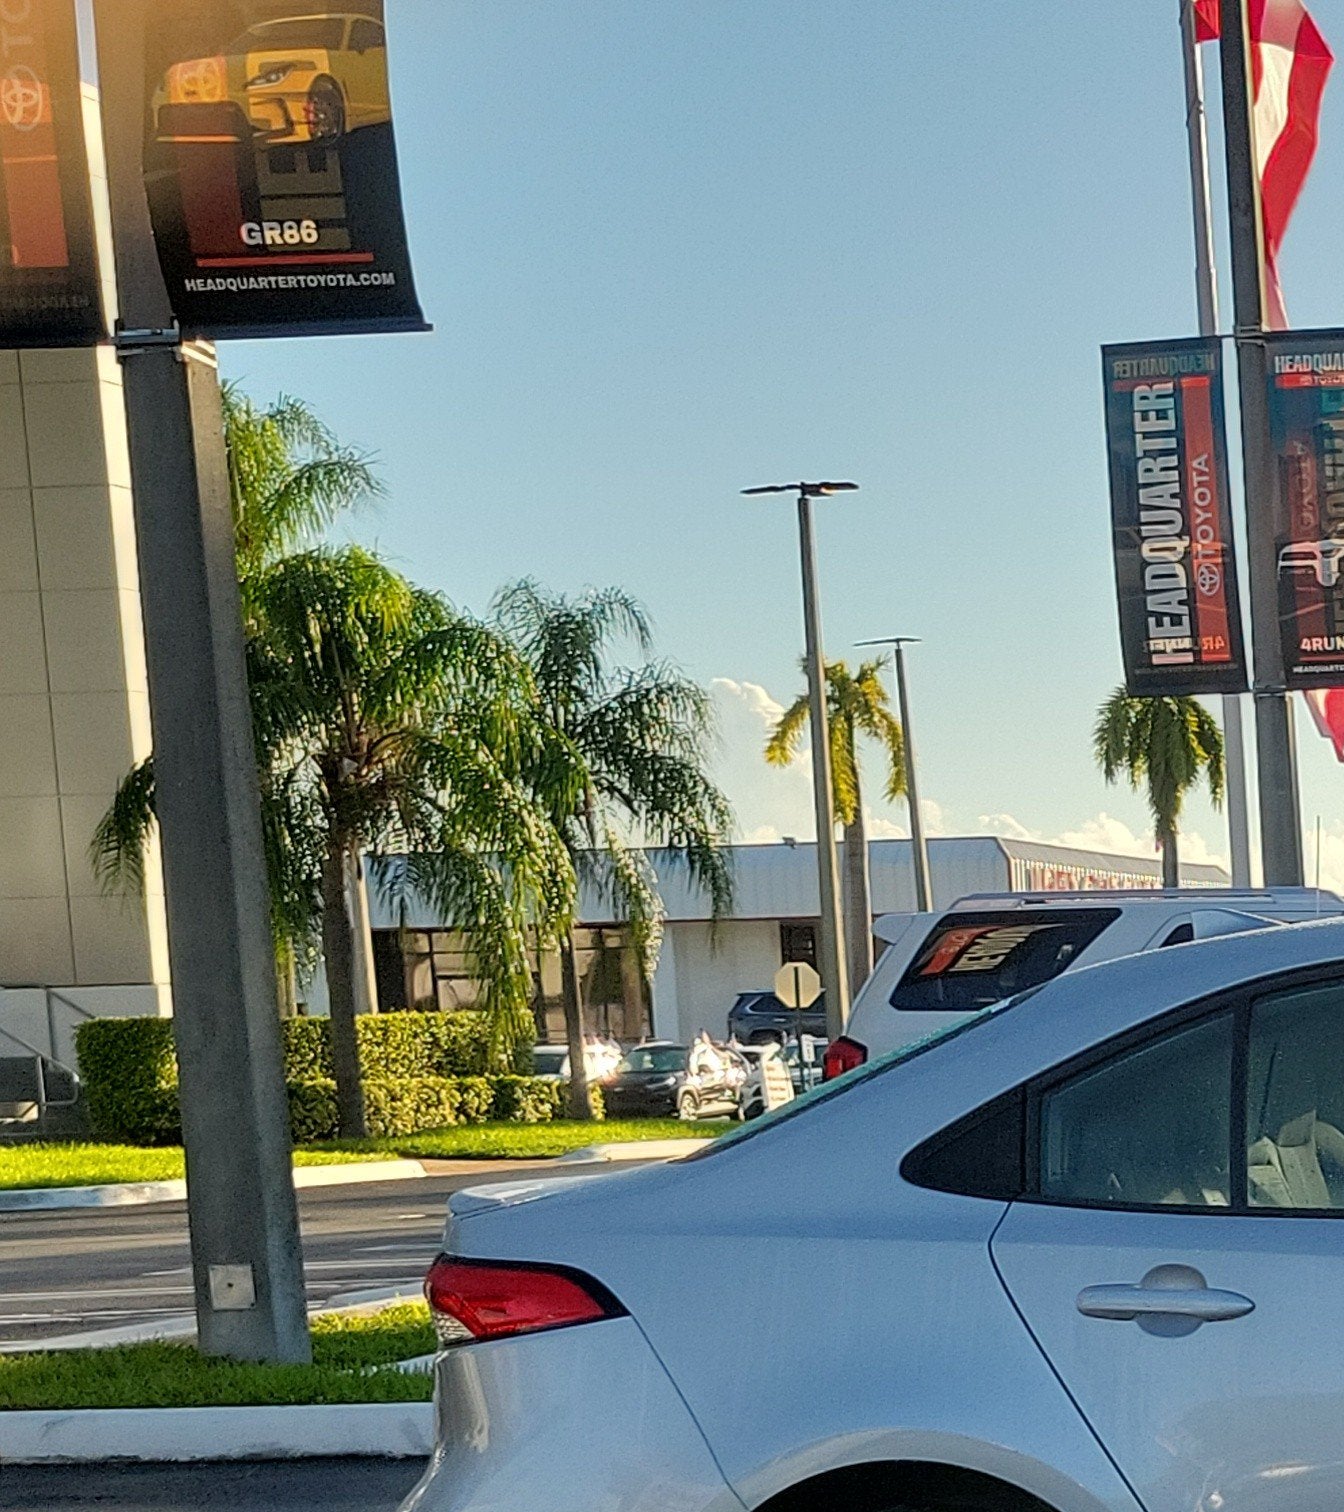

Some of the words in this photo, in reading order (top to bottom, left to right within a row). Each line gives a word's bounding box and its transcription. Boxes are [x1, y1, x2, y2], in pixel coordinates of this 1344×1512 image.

[240, 220, 319, 247] GR86
[184, 272, 396, 293] HEADQUARTERTOYOTA.COM
[1133, 381, 1195, 665] HEADQUARTER
[1191, 454, 1217, 553] TOYOTA
